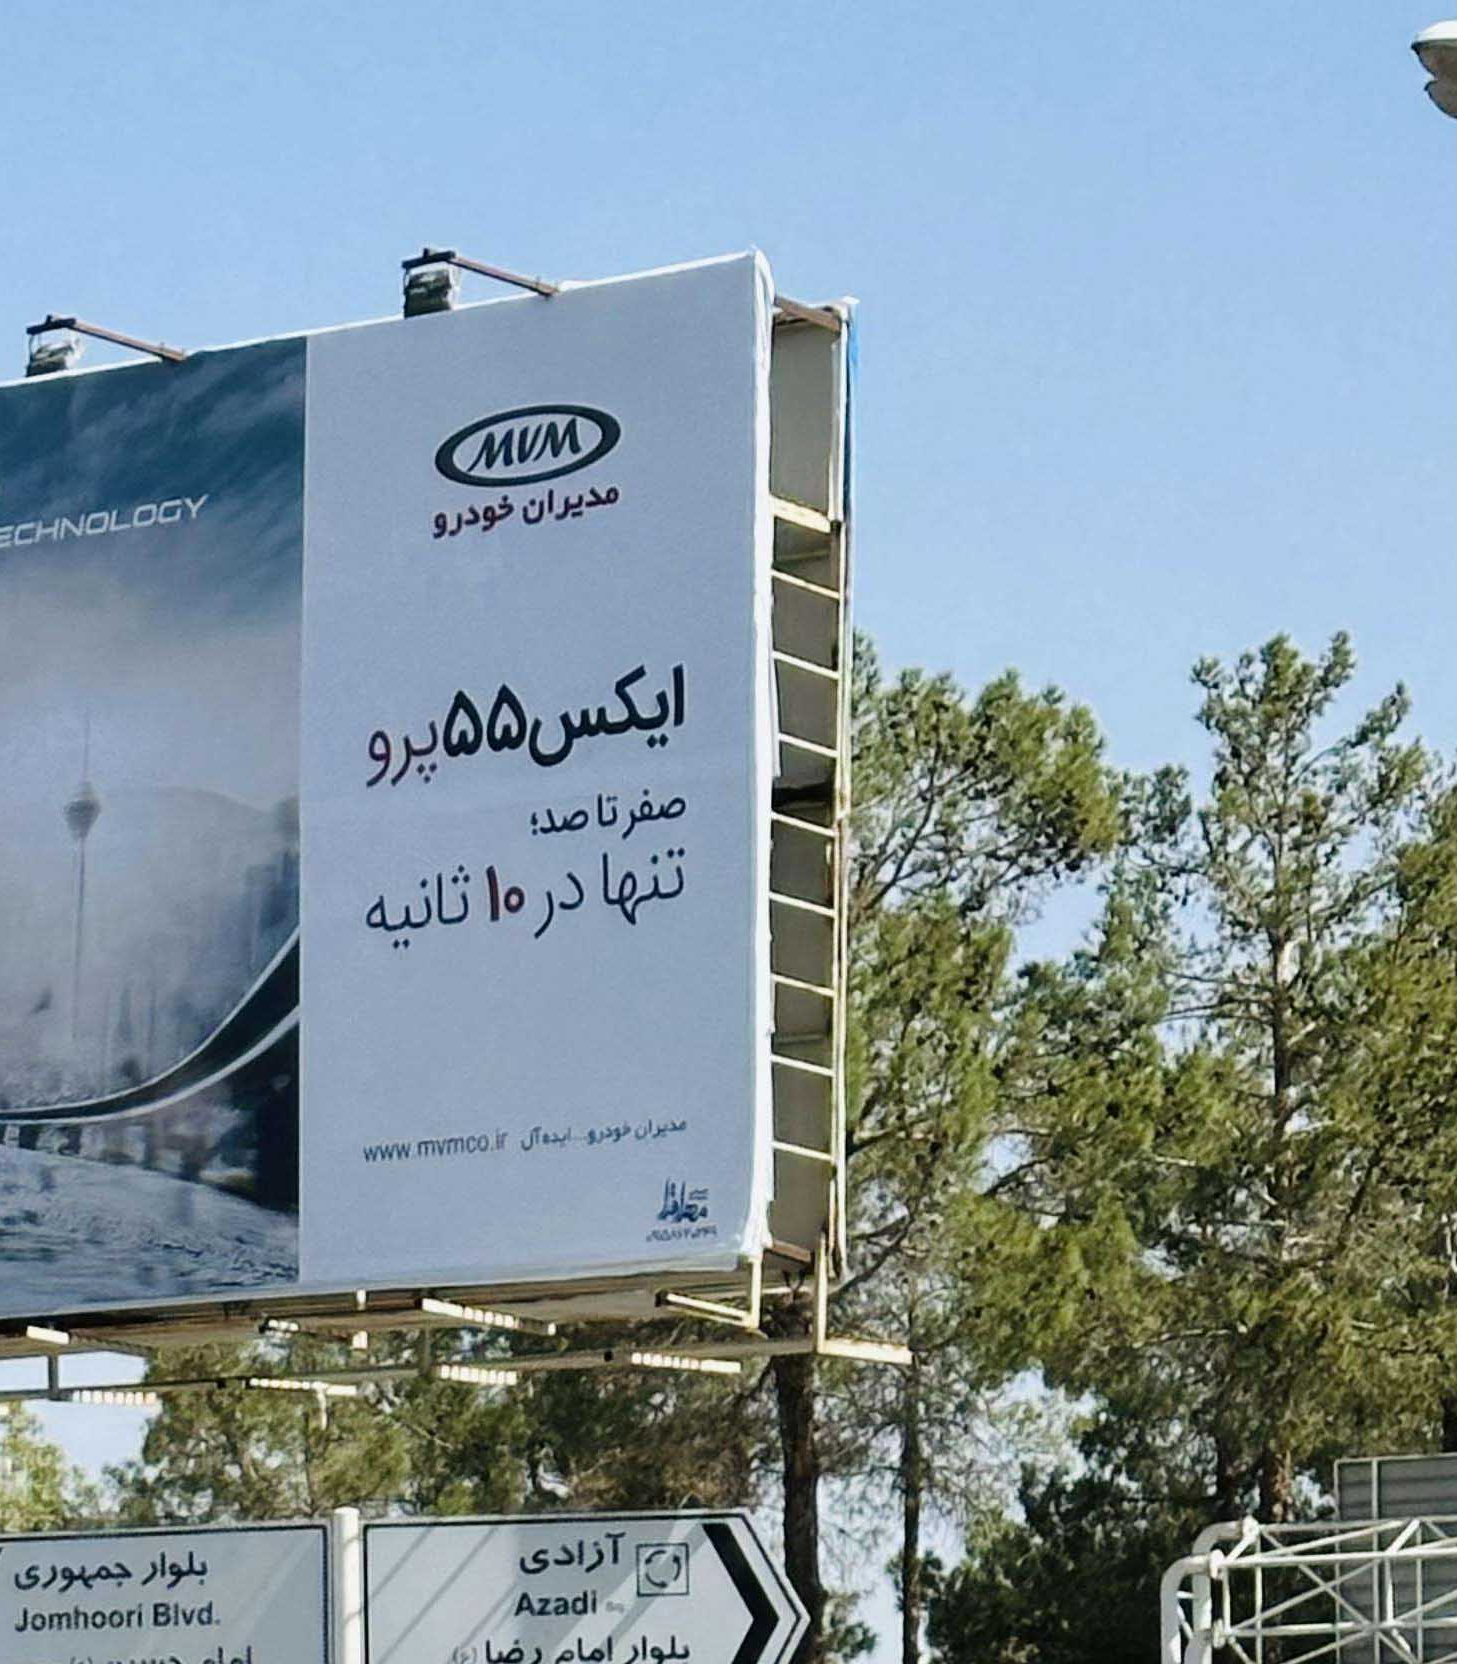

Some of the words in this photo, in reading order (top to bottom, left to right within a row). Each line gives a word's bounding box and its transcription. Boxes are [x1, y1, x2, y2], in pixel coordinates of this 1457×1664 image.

[468, 416, 583, 474] MVM
[433, 495, 514, 539] خودرو
[522, 486, 620, 526] مدیران
[366, 863, 470, 949] ثانیه
[487, 865, 524, 922] ۱۰
[533, 871, 585, 939] در
[602, 849, 685, 924] تنها
[142, 1551, 208, 1589] بلوار
[519, 1533, 626, 1574] آزادی
[14, 1561, 132, 1591] جمهوری
[15, 1603, 143, 1632] Jomhoori
[153, 1601, 221, 1628] Blvd.
[515, 1592, 597, 1617] Azadi
